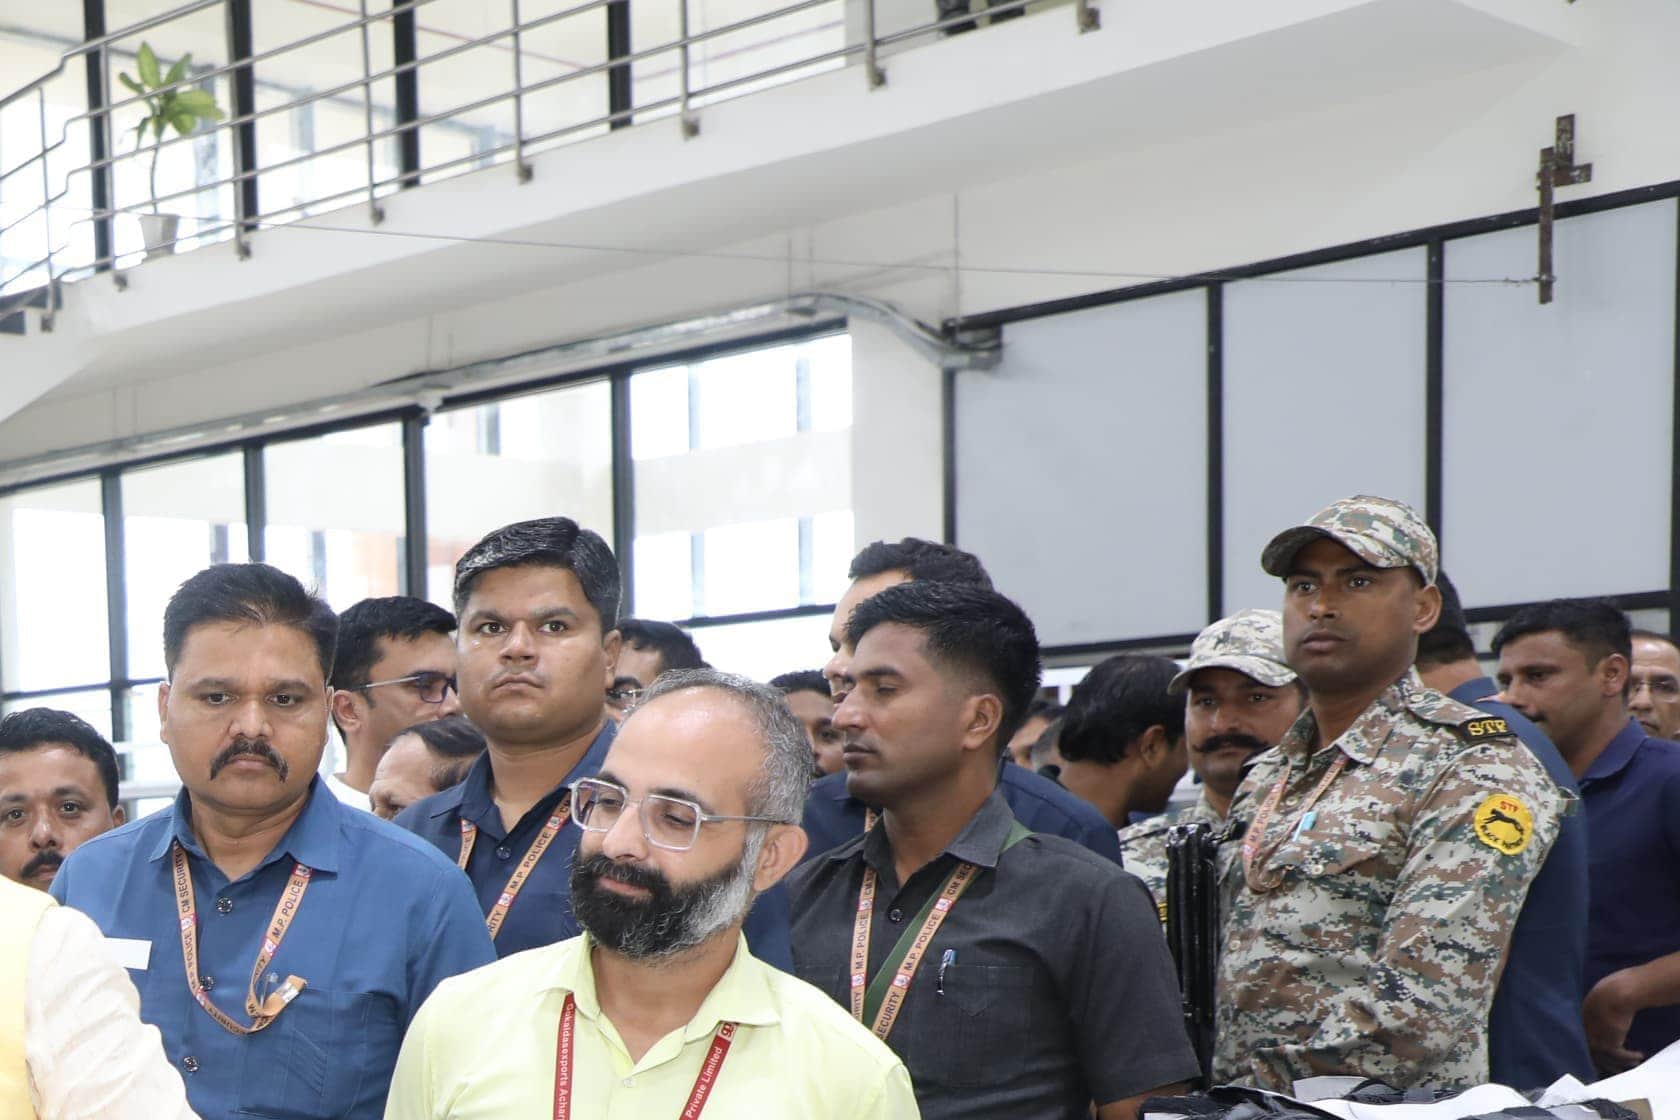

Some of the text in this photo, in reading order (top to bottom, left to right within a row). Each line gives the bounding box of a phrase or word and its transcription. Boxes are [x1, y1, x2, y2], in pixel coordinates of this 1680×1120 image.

[524, 831, 552, 868] POLICE
[175, 849, 189, 898] SECURITY
[282, 880, 304, 917] POLICE
[857, 912, 869, 949] POLICE
[915, 913, 940, 950] POLICE
[684, 1083, 707, 1119] Private
[702, 1046, 723, 1084] Limited
